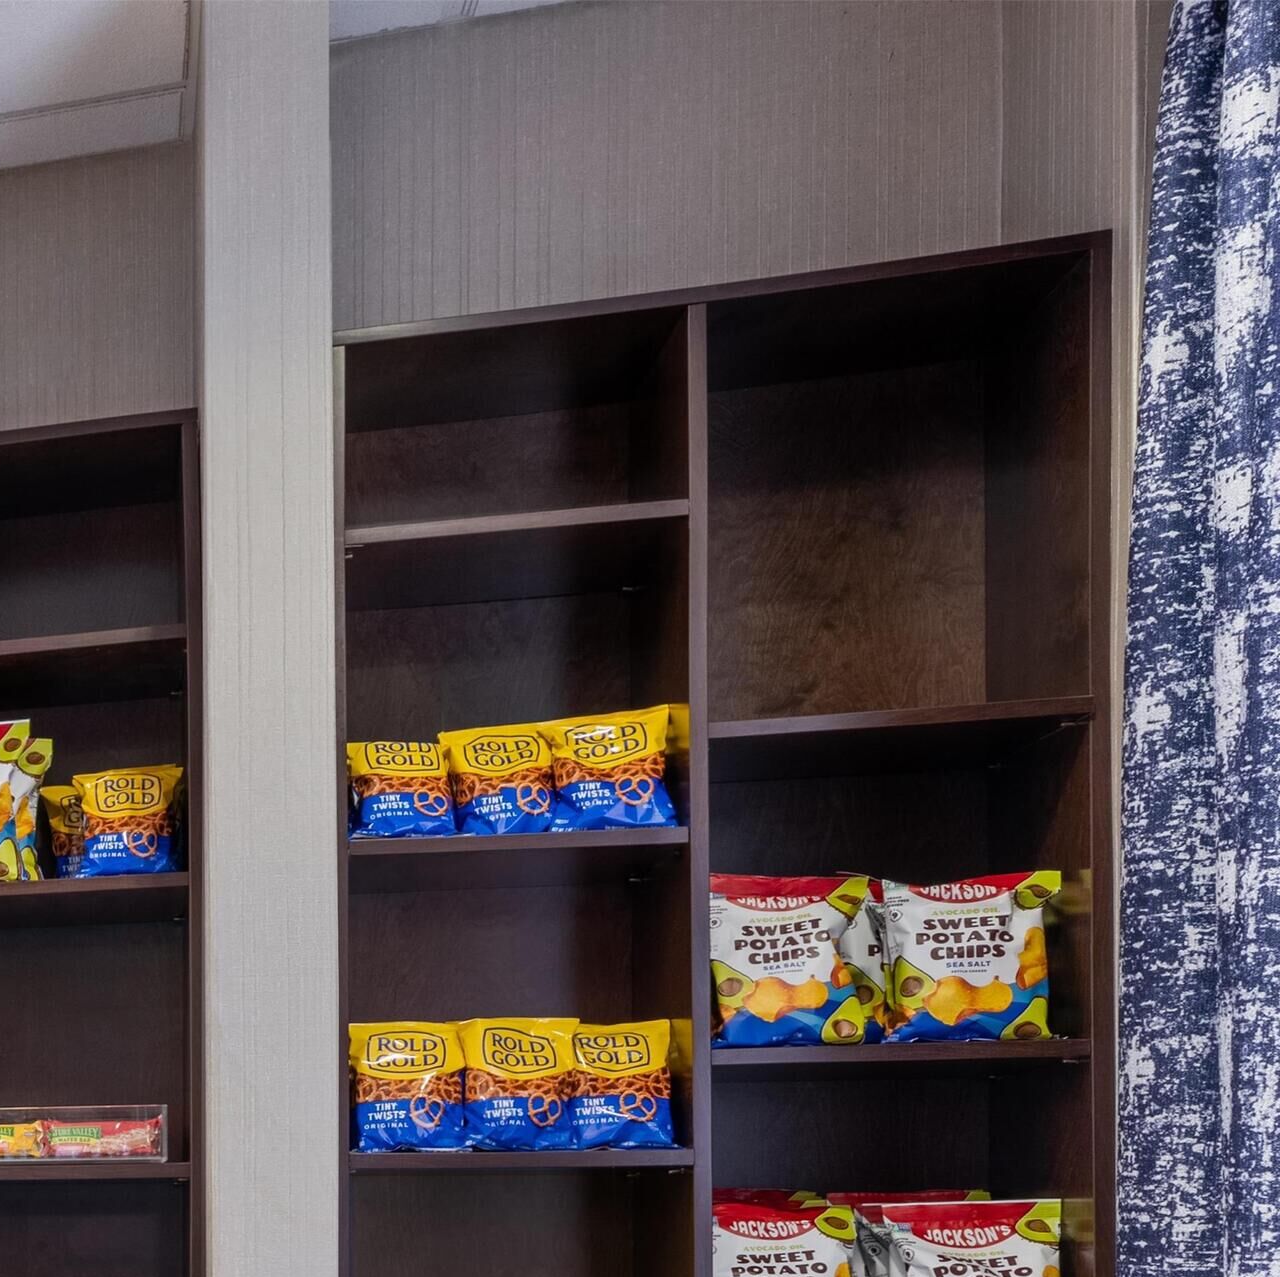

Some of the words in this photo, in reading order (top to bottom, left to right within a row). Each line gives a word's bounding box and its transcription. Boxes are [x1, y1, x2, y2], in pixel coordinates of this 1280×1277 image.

[376, 753, 434, 766] GOLD
[104, 777, 154, 792] ROLD
[578, 782, 601, 792] TINY
[104, 791, 154, 807] GOLD
[379, 795, 401, 803] TINY
[481, 795, 504, 805] TINY
[571, 789, 610, 800] TWISTS
[372, 801, 410, 811] TWISTS
[370, 811, 414, 820] ORIGINAL
[931, 908, 979, 916] AVOCADO
[741, 917, 823, 937] SWEET
[923, 915, 1009, 931] SWEET
[734, 930, 831, 951] POTATO
[915, 929, 1015, 945] POTATO
[748, 946, 820, 965] CHIPS
[930, 944, 1006, 960] CHIPS
[763, 963, 780, 971] SEA
[783, 962, 806, 970] SALT
[968, 960, 991, 968] SALT
[378, 1037, 437, 1052] ROLD
[492, 1034, 544, 1054] ROLD
[492, 1050, 549, 1067] GOLD
[375, 1103, 397, 1111] TINY
[493, 1100, 515, 1109] TINY
[368, 1111, 407, 1120] TWISTS
[364, 1121, 408, 1130] ORIGINAL
[729, 1219, 812, 1239] JACKSON'S
[923, 1224, 1012, 1248] JACKSON'S
[743, 1245, 783, 1253] AVOCADO
[736, 1249, 816, 1264] SWEET
[732, 1262, 827, 1277] POTATO
